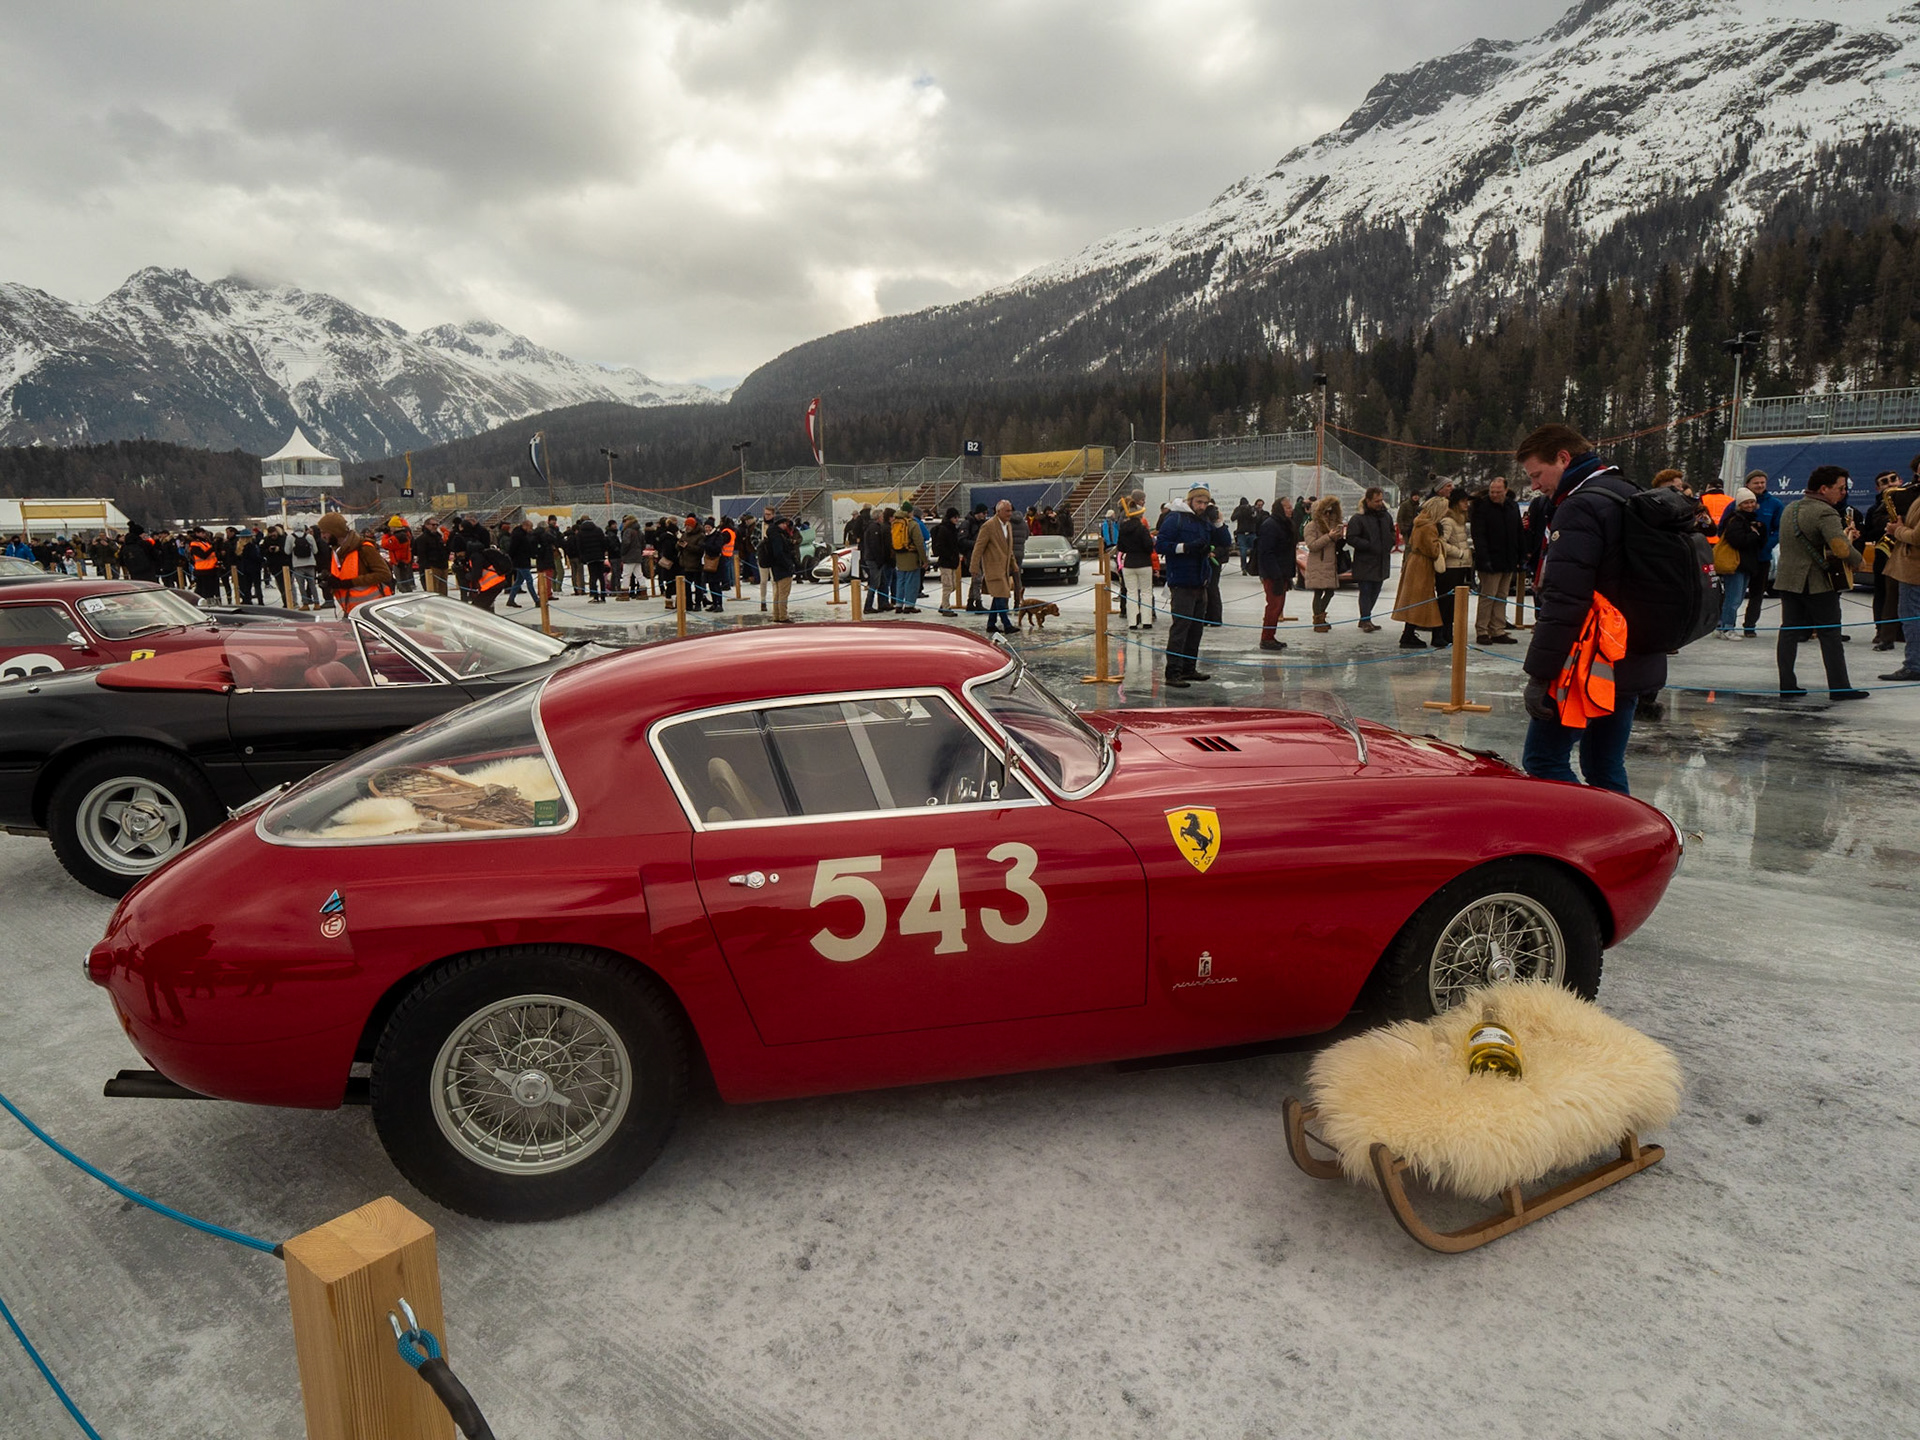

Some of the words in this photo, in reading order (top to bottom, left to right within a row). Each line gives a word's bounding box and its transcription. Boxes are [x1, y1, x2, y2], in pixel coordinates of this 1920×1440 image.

[967, 441, 979, 451] B2
[1038, 460, 1060, 468] PUBLIC
[89, 603, 103, 612] 25
[809, 842, 1048, 962] 543
